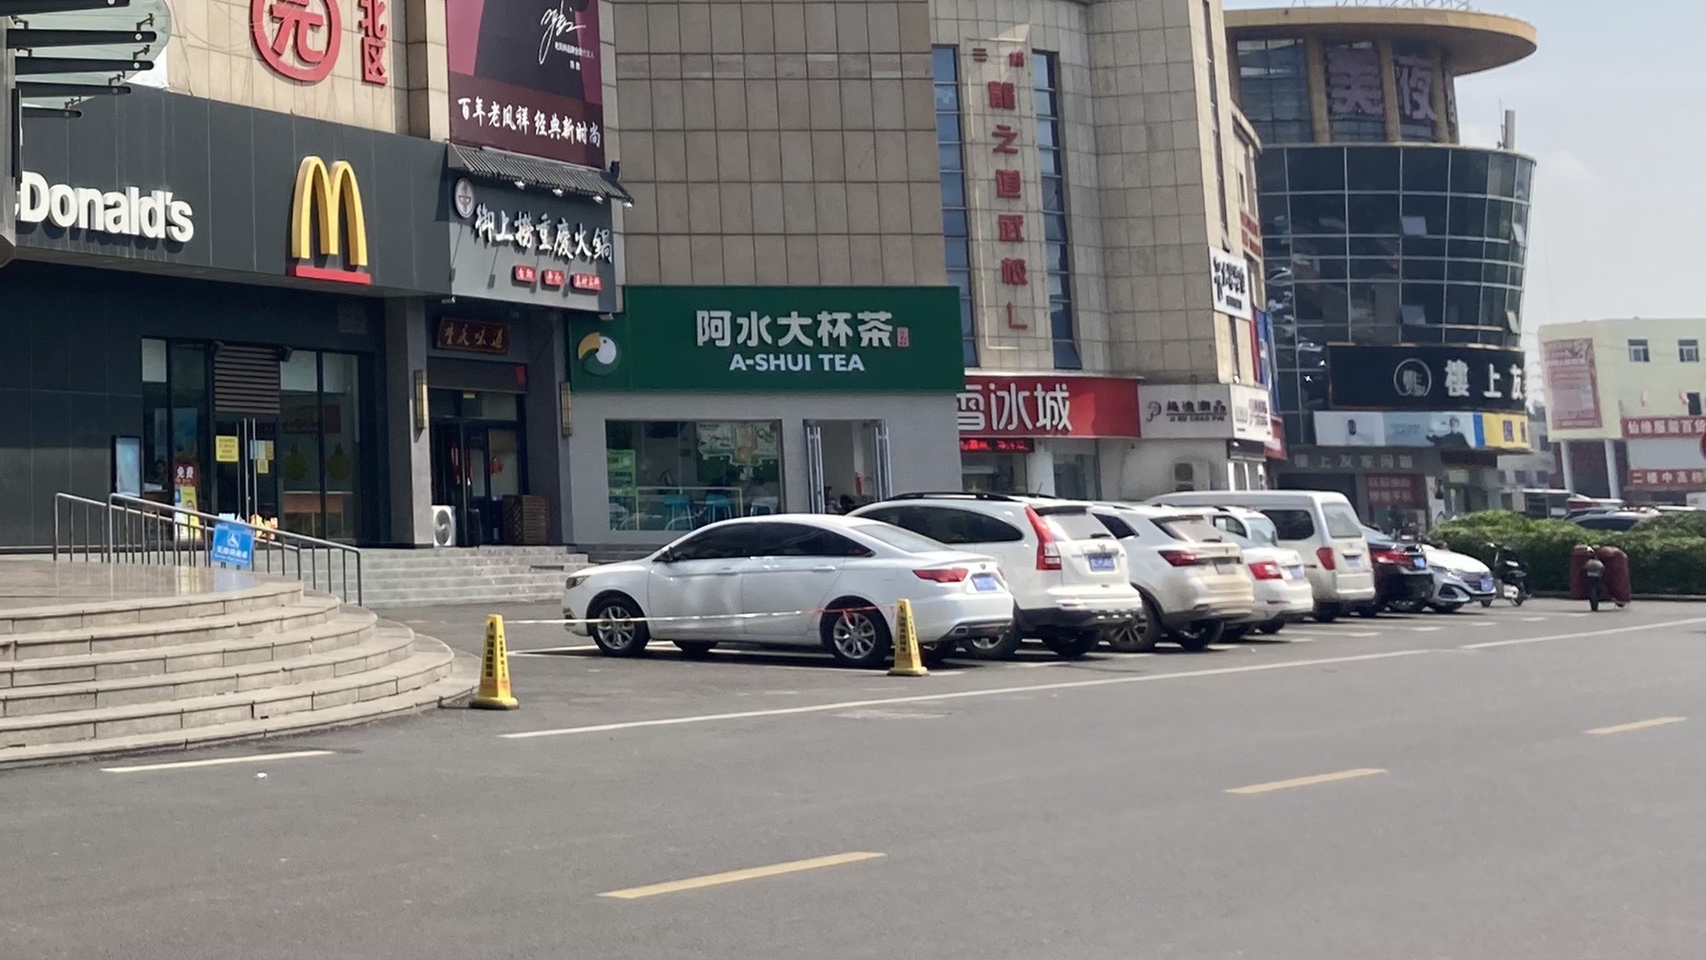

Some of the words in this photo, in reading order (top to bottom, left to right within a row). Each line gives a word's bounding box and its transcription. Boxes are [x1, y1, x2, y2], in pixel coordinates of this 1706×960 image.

[458, 96, 530, 135] 百年老凤祥
[534, 109, 601, 148] 经典新时尚
[696, 310, 893, 347] 阿水大杯茶
[729, 353, 811, 372] A-SHUI
[818, 353, 866, 372] TEA
[956, 383, 1073, 432] 雪冰城
